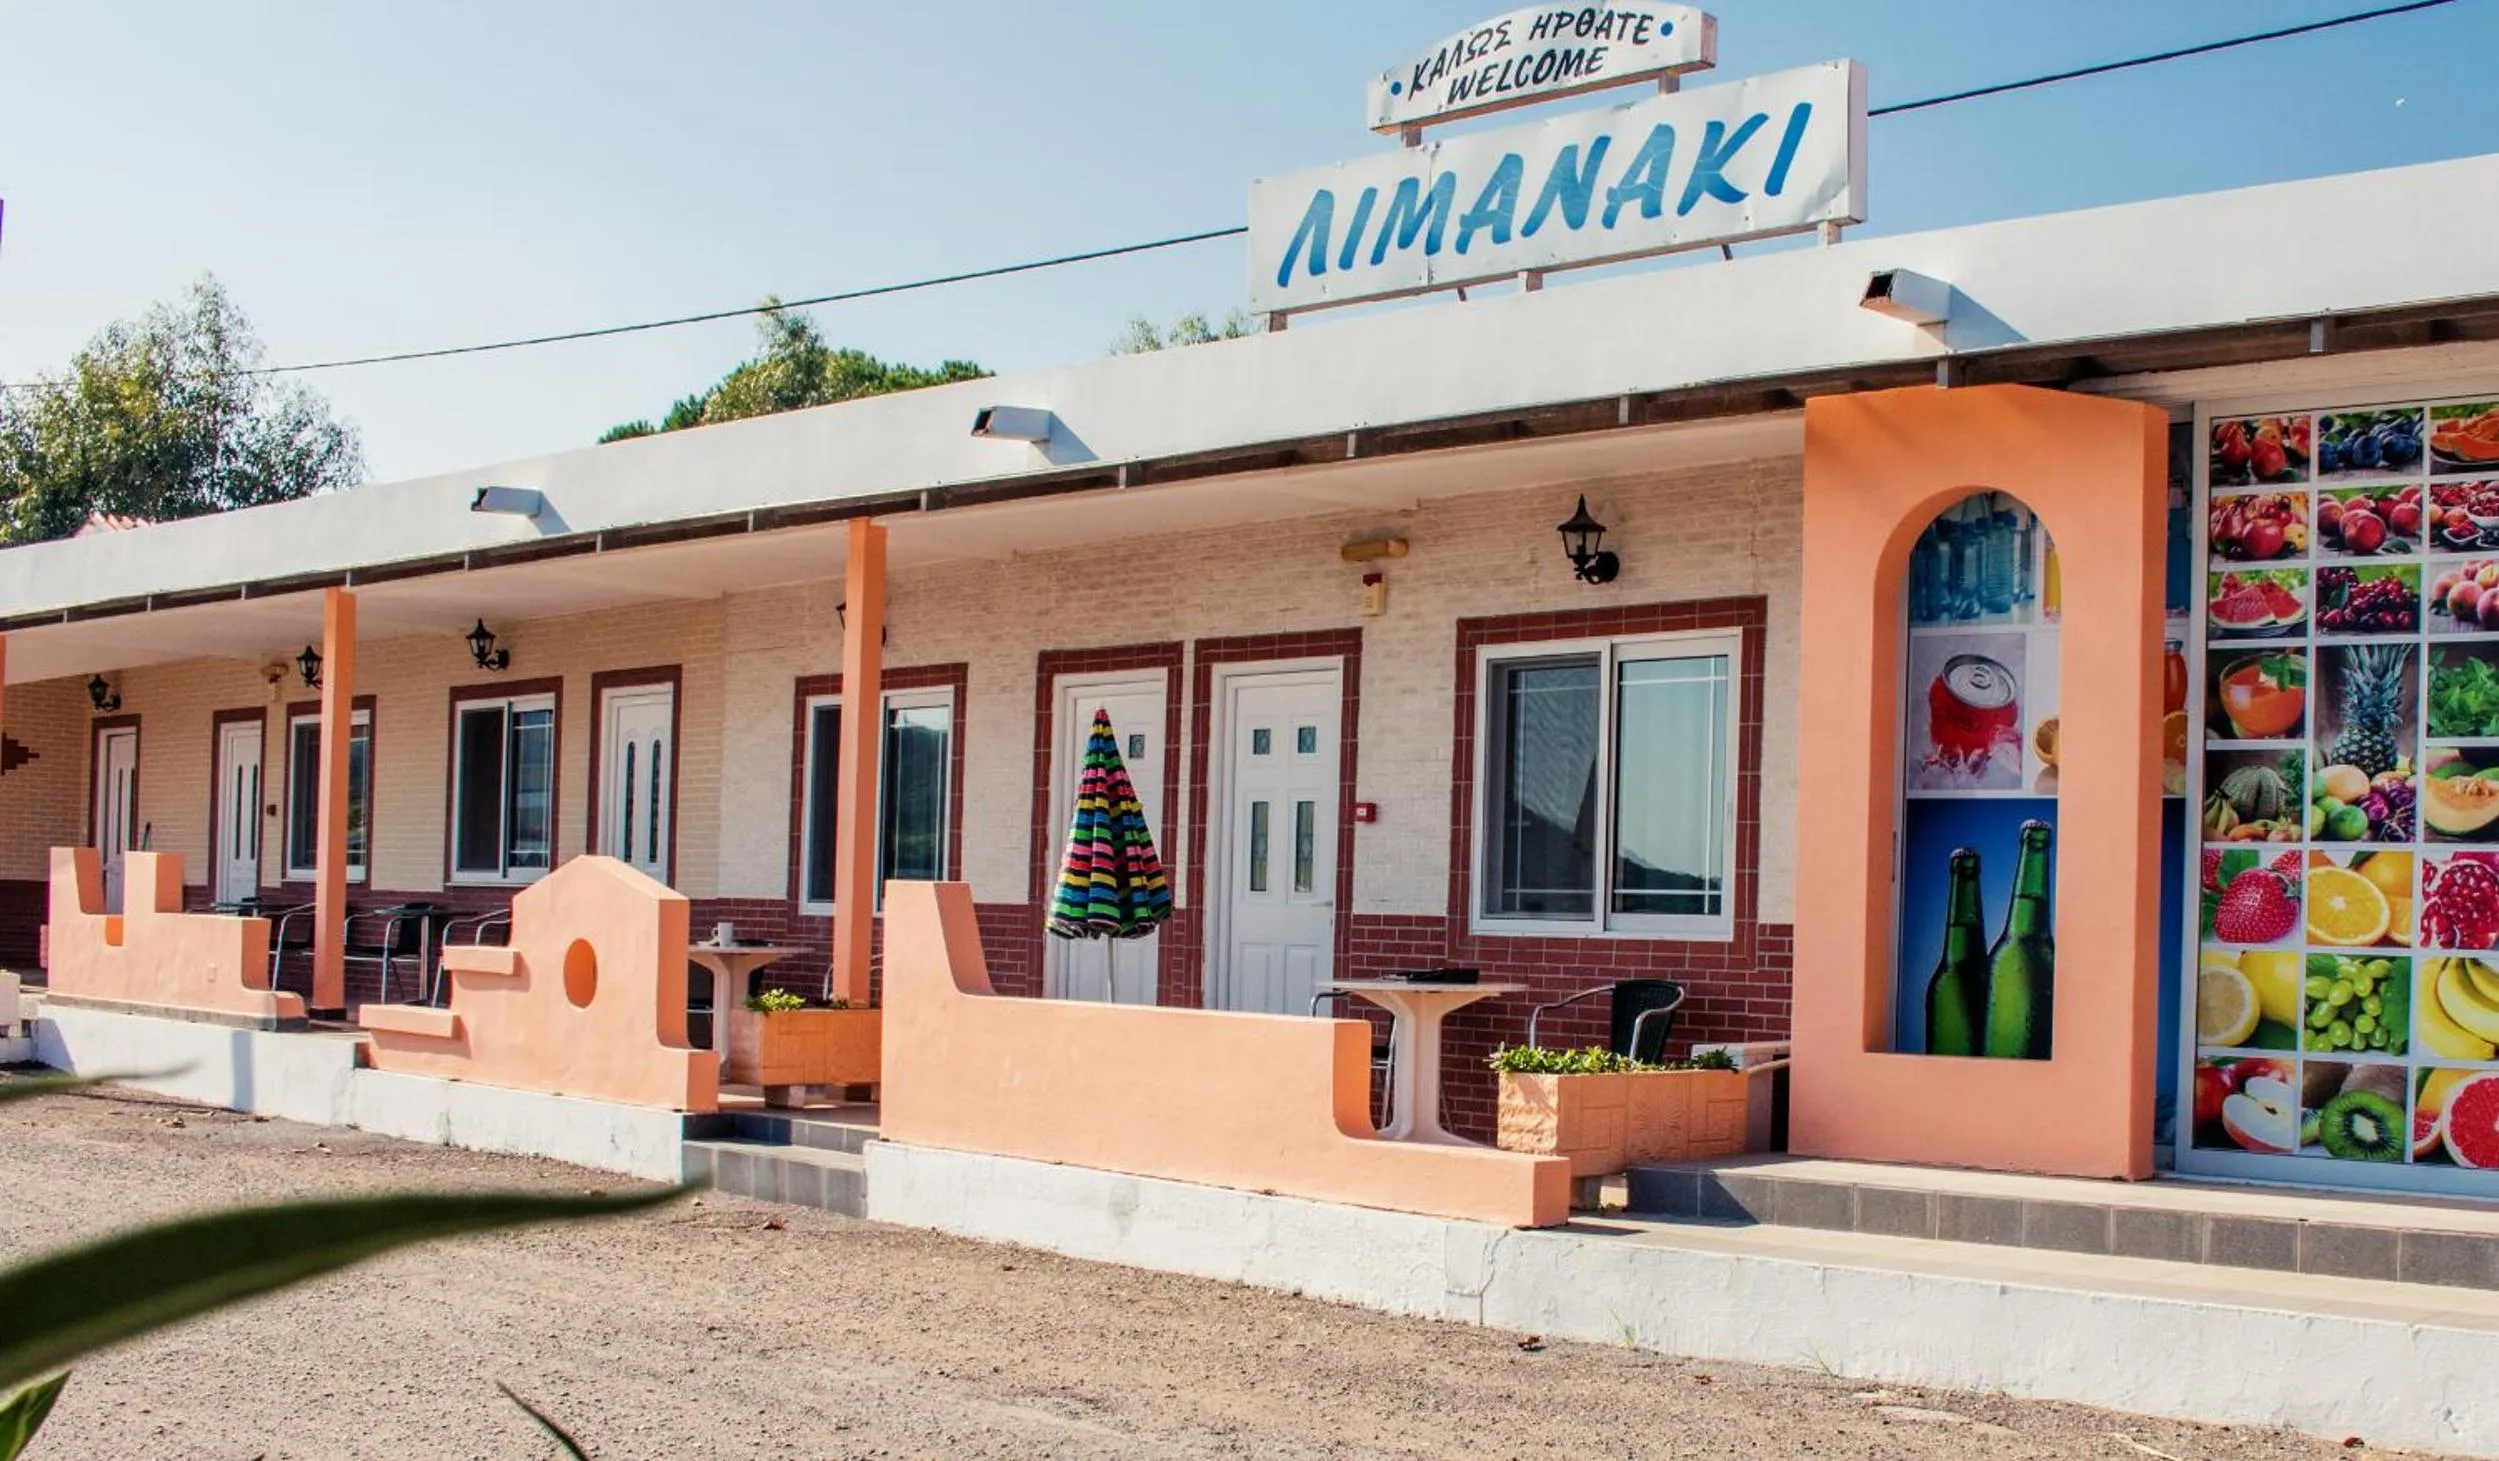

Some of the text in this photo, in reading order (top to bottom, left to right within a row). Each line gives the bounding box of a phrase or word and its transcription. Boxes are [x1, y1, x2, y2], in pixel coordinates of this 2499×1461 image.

[1408, 7, 1654, 101] ΚΑΛΩΣ ΗΡΘΑΤΕ
[1447, 46, 1609, 105] WELCOME
[1277, 102, 1812, 288] ΛΙΜΑΝΑΚΙ
